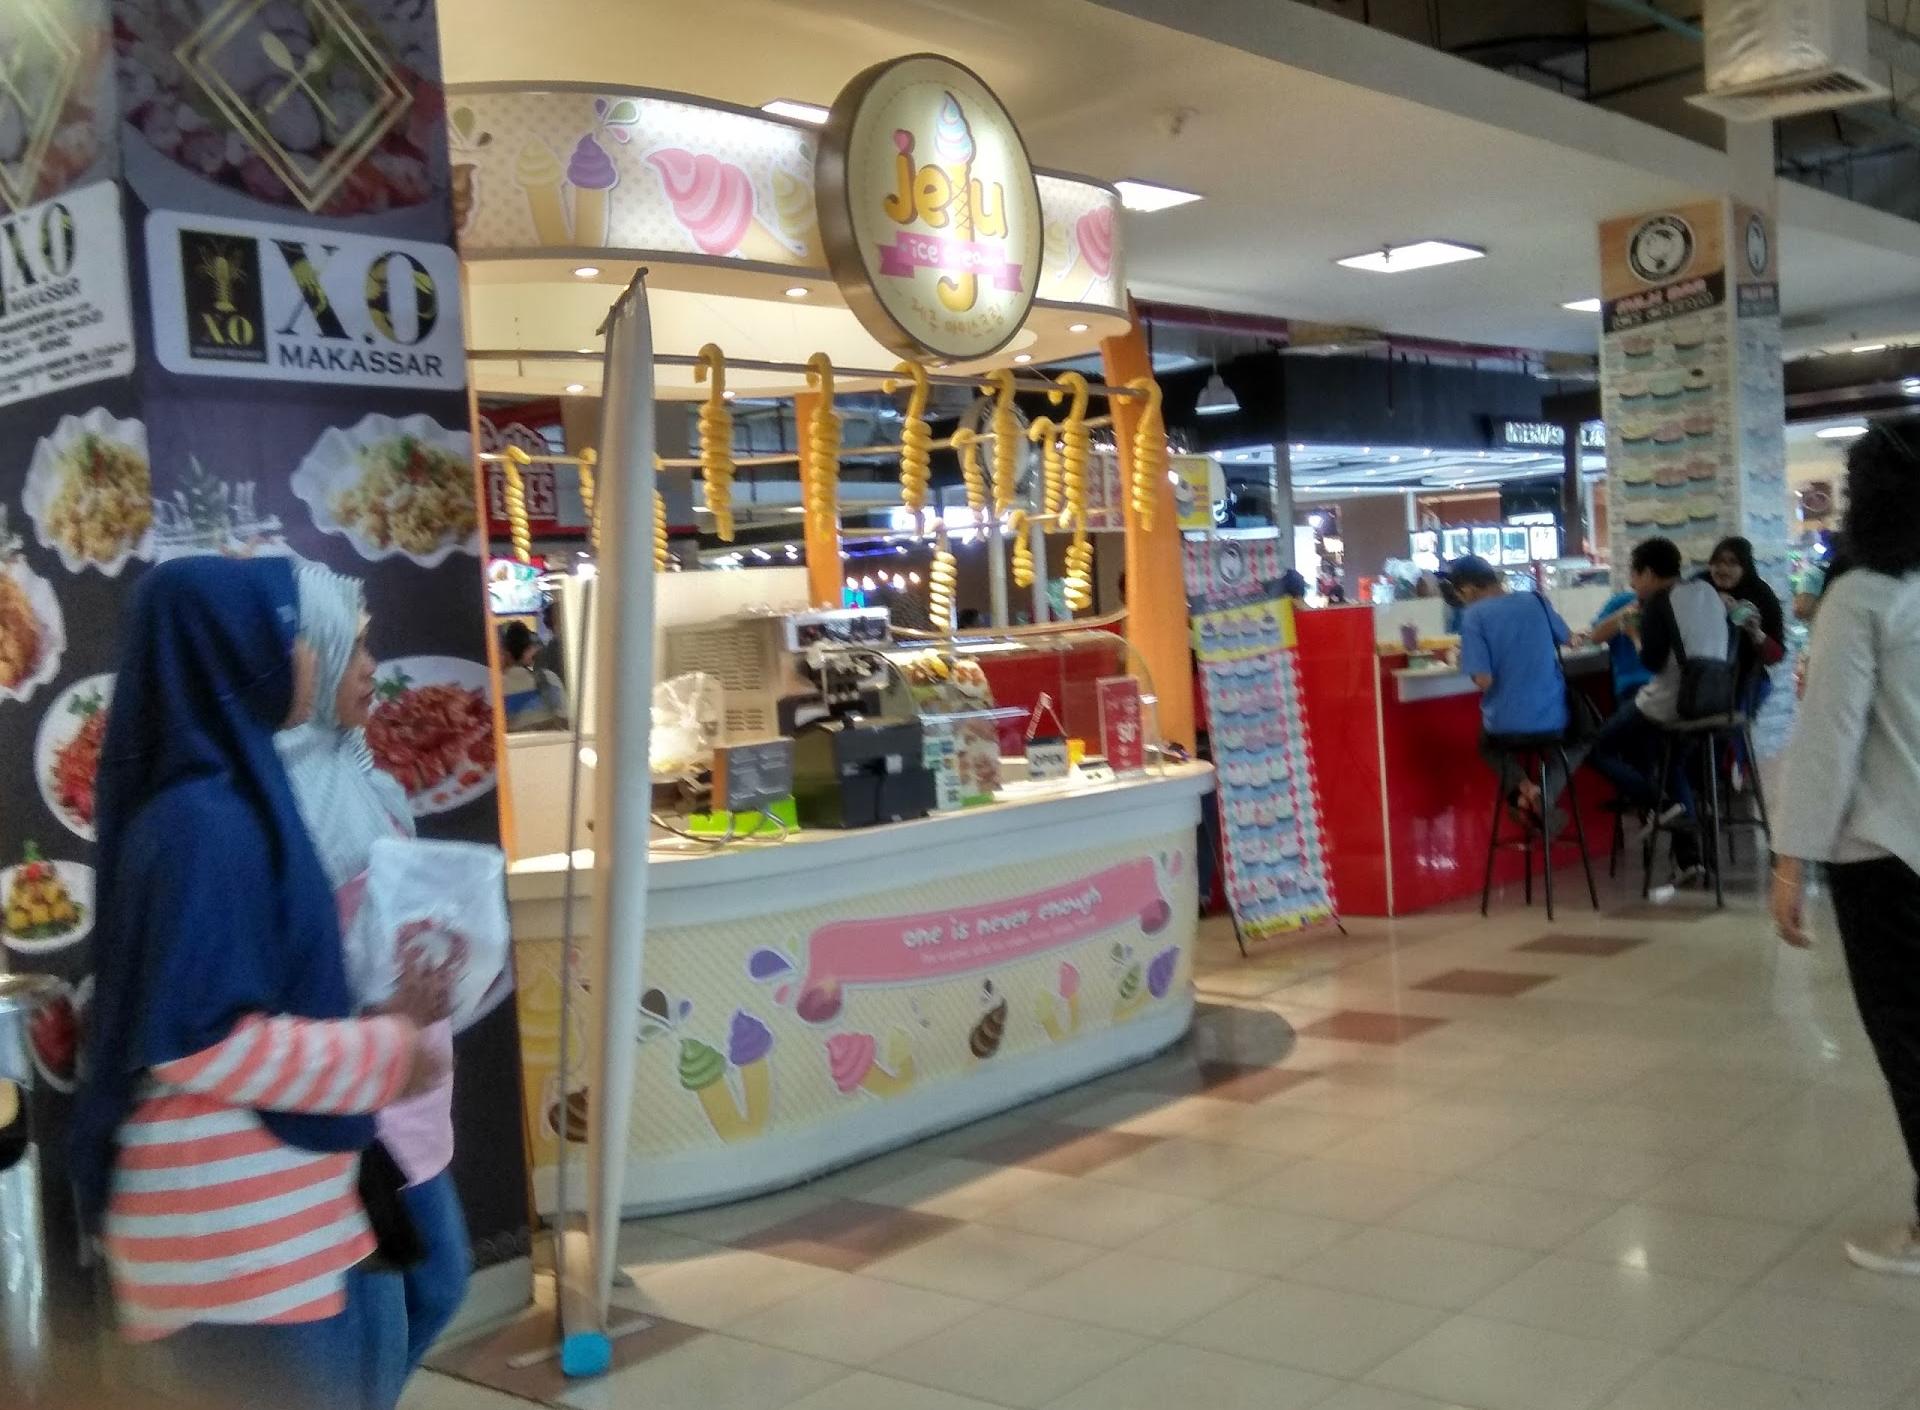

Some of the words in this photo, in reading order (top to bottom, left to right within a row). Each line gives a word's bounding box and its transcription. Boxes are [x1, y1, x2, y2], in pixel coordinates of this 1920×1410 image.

[270, 238, 440, 346] X.O
[278, 344, 444, 378] MAKASSAR
[976, 909, 1030, 935] never
